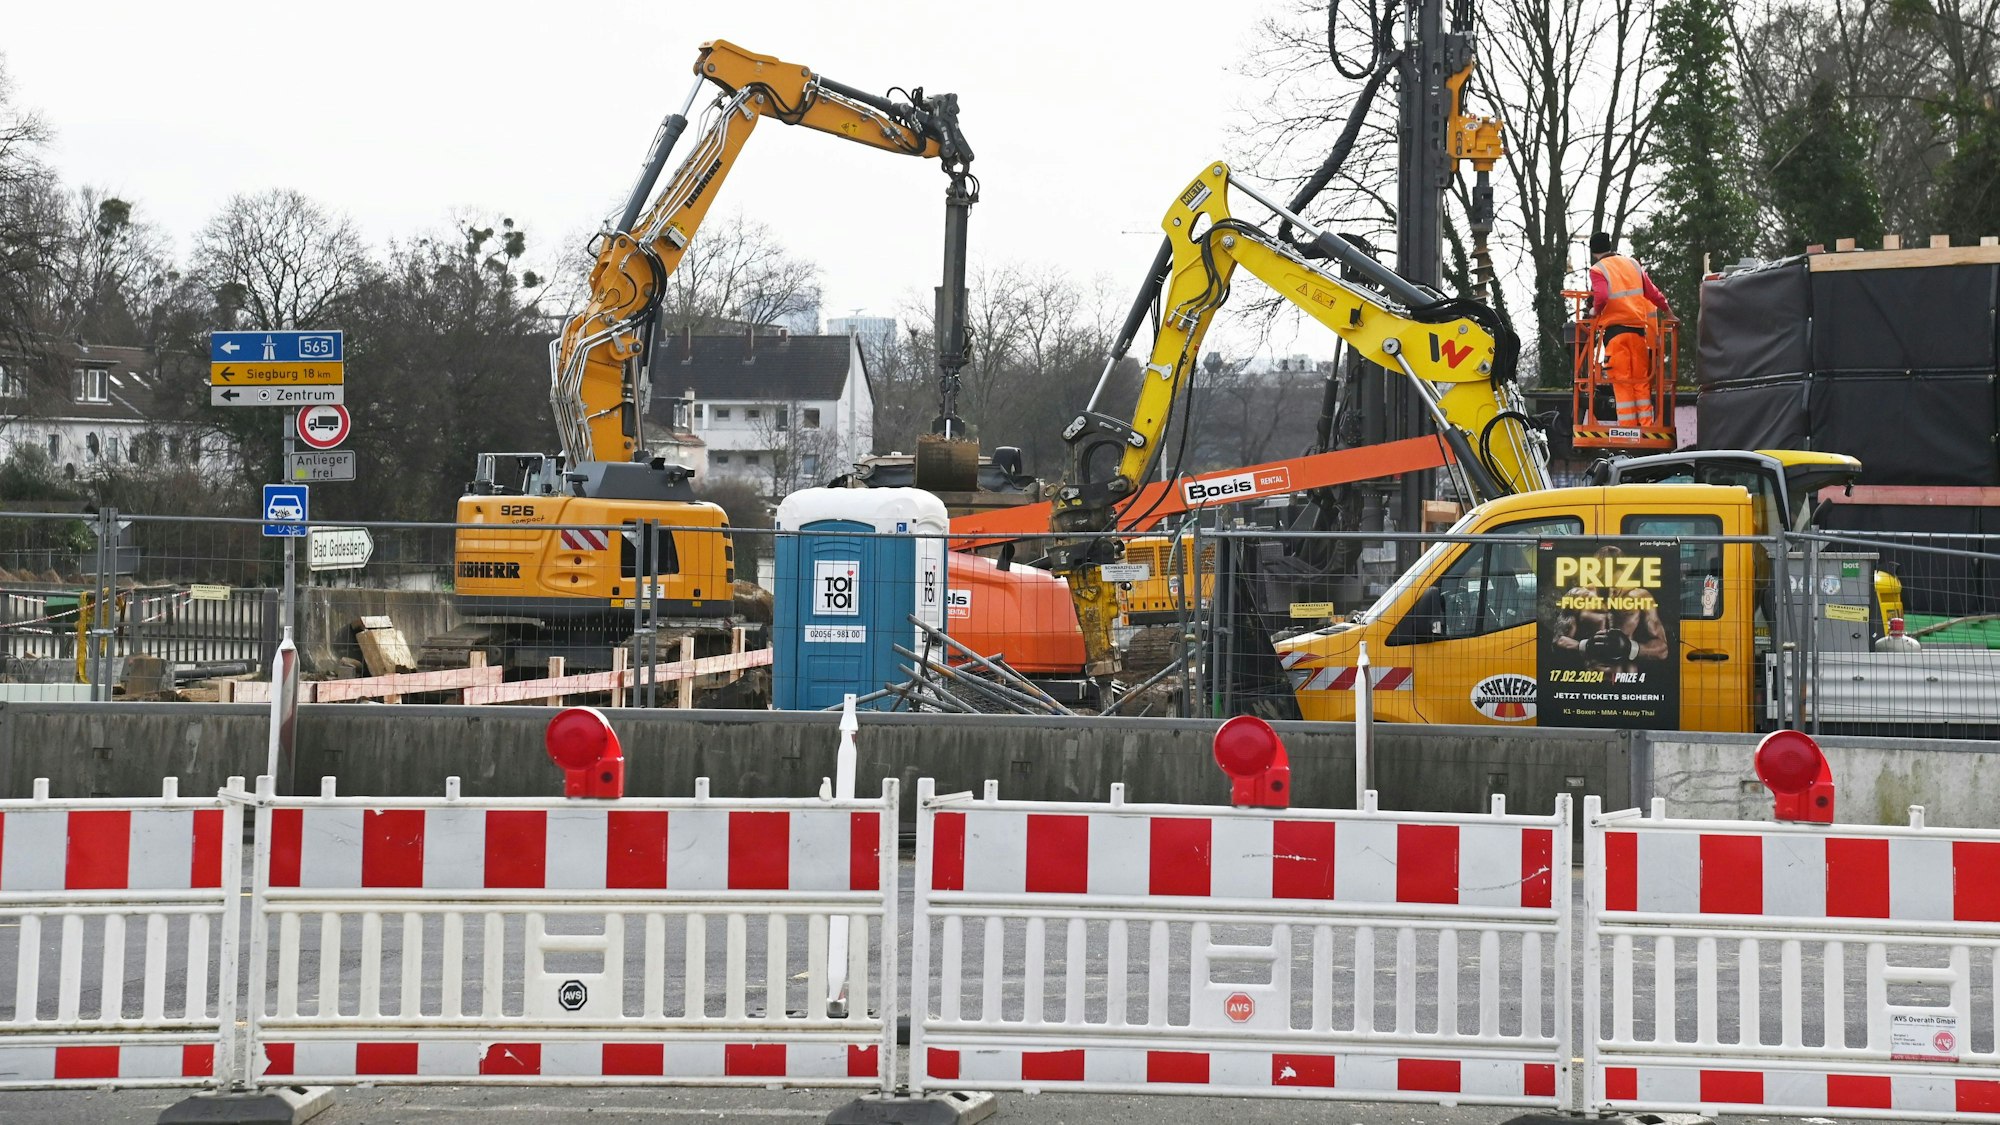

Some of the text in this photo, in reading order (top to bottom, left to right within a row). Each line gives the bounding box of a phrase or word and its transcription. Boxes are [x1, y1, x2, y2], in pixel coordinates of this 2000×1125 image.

[1182, 182, 1205, 205] MIETE
[304, 340, 329, 353] 565
[247, 368, 331, 381] Siegburg 18 km
[276, 389, 335, 401] Zentrum
[1610, 429, 1639, 437] Boels
[296, 455, 348, 467] Anlieger
[312, 467, 334, 478] frei
[1188, 476, 1284, 500] Boels RENTAL
[500, 505, 534, 516] 926
[511, 515, 545, 524] compact
[313, 536, 365, 560] Bad Godesberg
[1555, 556, 1662, 588] PRIZE
[824, 592, 852, 609] TOI
[924, 587, 935, 603] TOI
[947, 592, 968, 605] els
[810, 630, 832, 638] 02056
[837, 630, 849, 638] 981
[1549, 669, 1646, 683] 17.02.2024 PRIZE 4
[1479, 677, 1537, 696] FEICKERT
[1553, 692, 1581, 700] JETZT
[1621, 693, 1660, 701] SICHERN
[1622, 710, 1640, 718] Muay
[564, 991, 582, 1000] AVS
[1230, 1003, 1250, 1012] AVS
[1908, 1016, 1935, 1024] Overath
